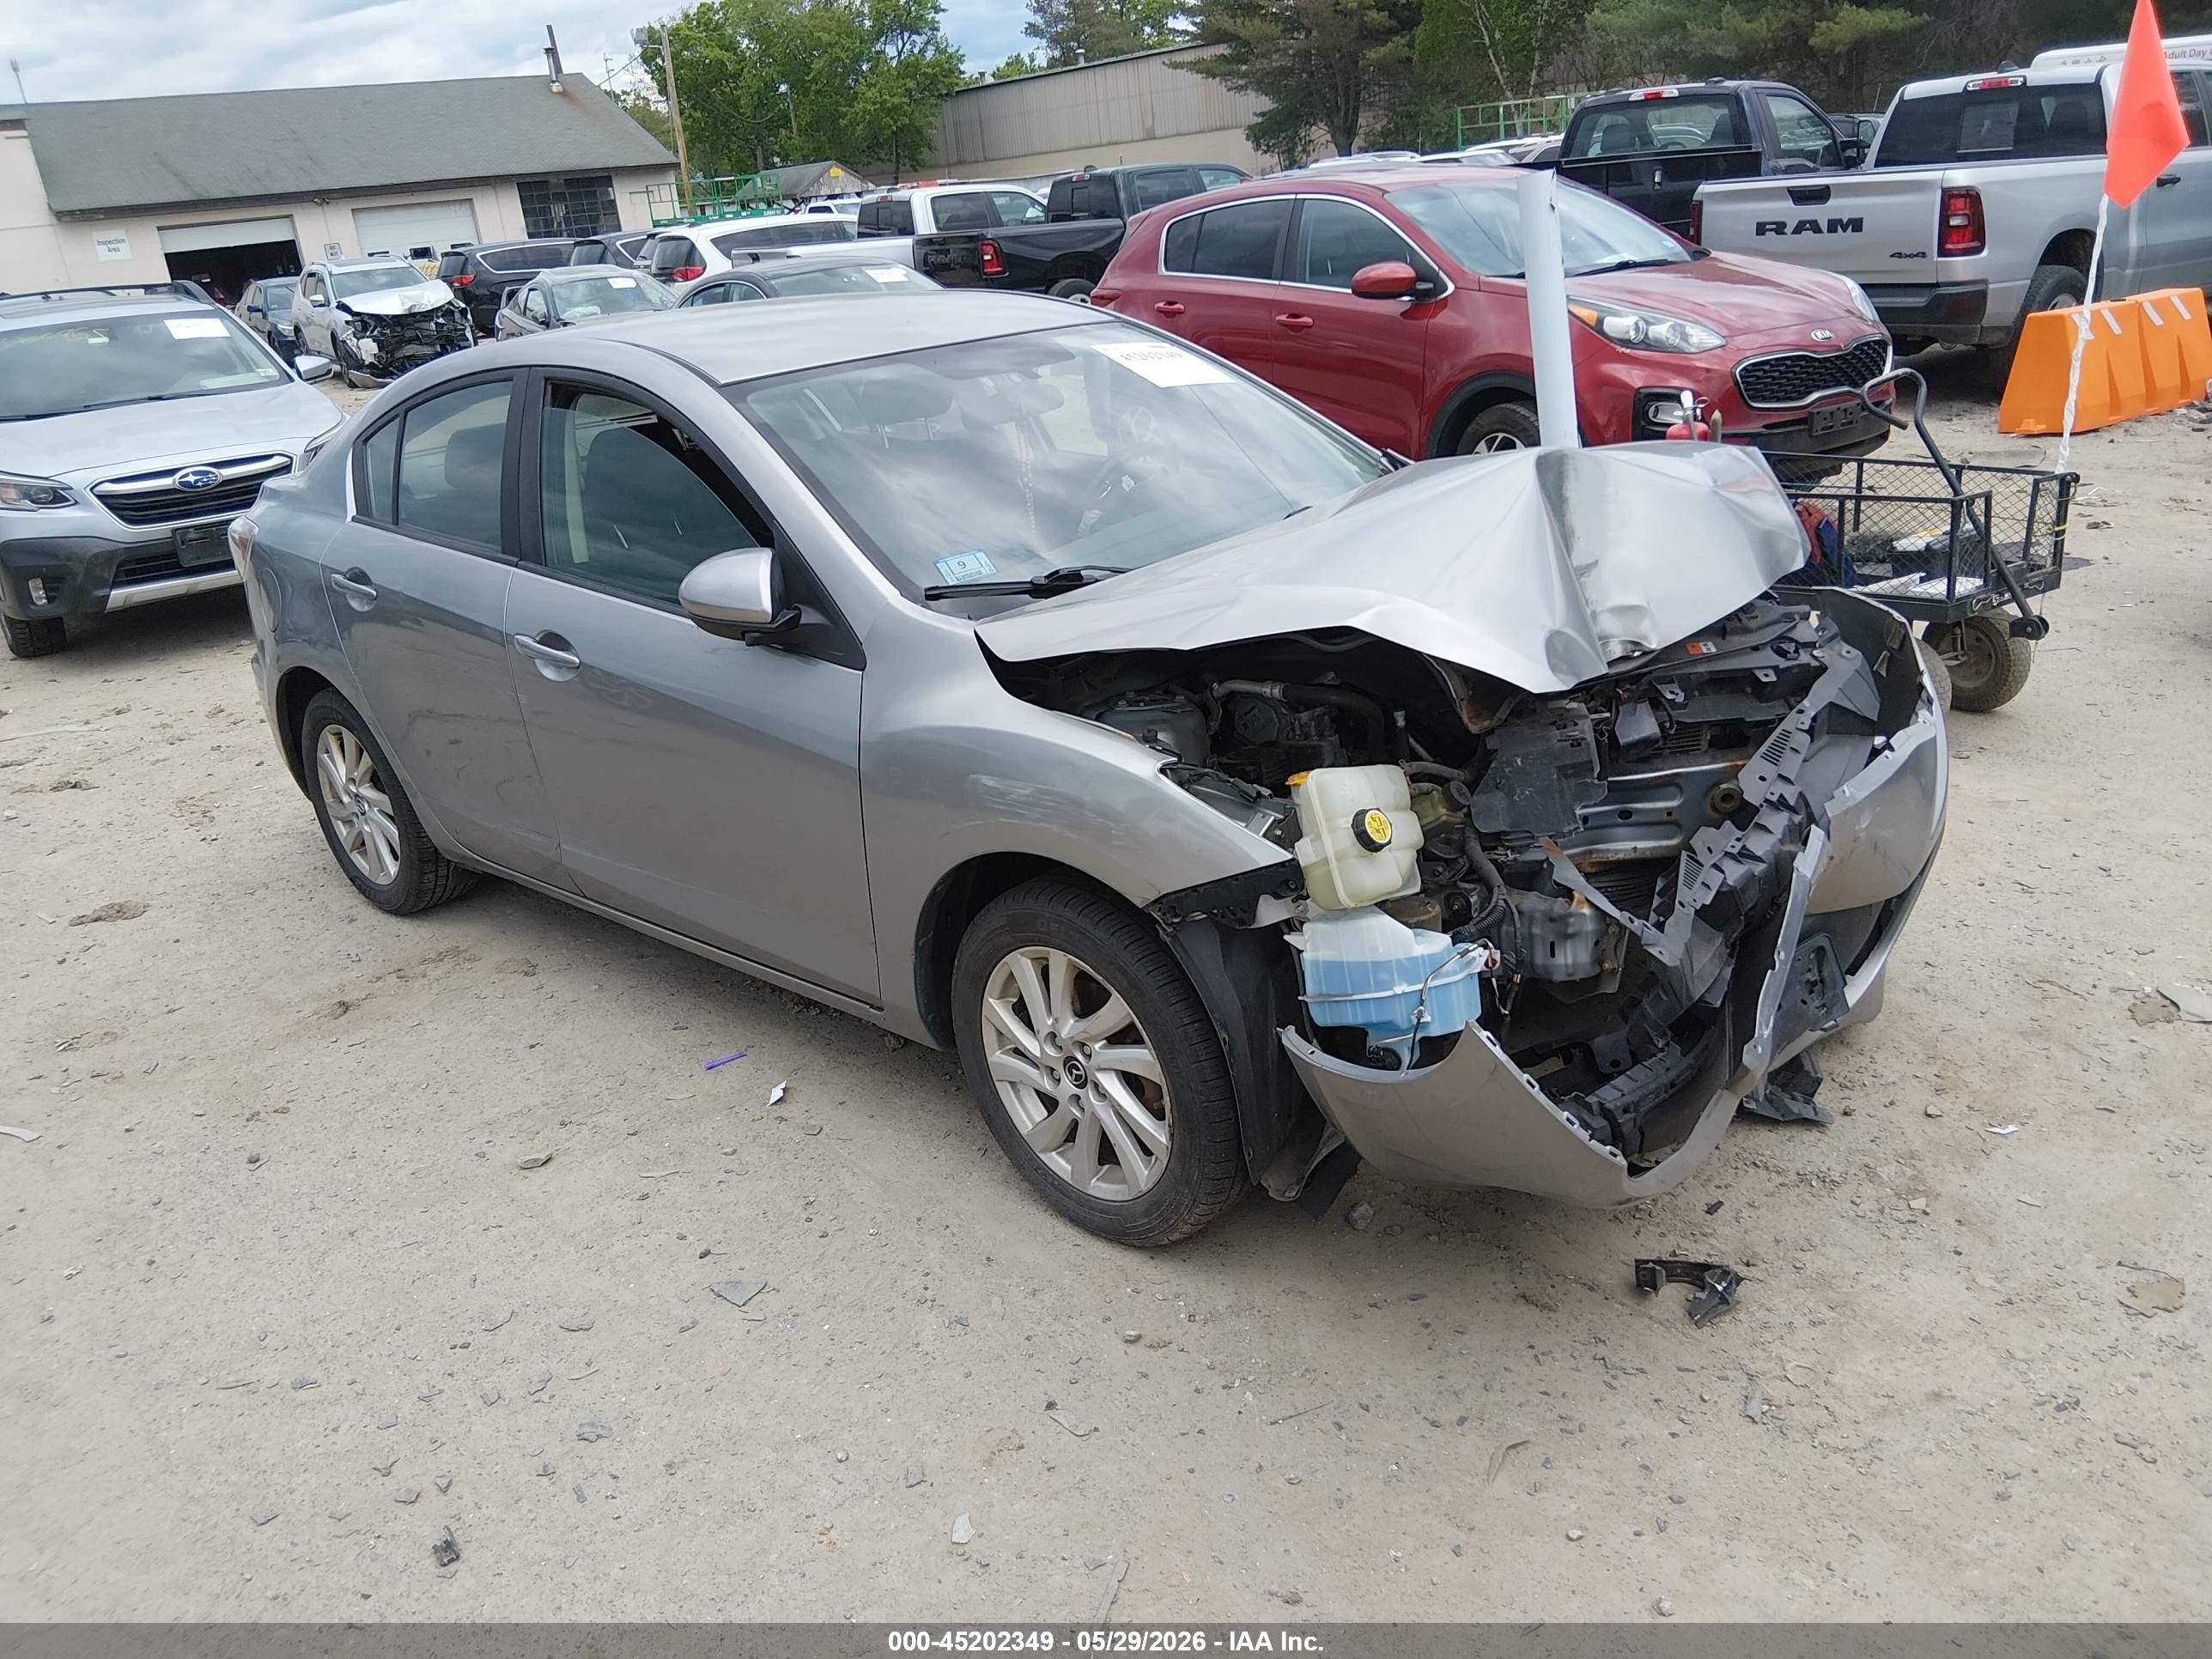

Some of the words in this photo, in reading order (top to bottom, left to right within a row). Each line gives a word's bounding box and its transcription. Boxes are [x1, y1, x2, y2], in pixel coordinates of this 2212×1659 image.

[2189, 48, 2207, 59] Day
[1755, 217, 1863, 236] RAM
[96, 238, 126, 246] Inspection
[957, 560, 967, 570] 9
